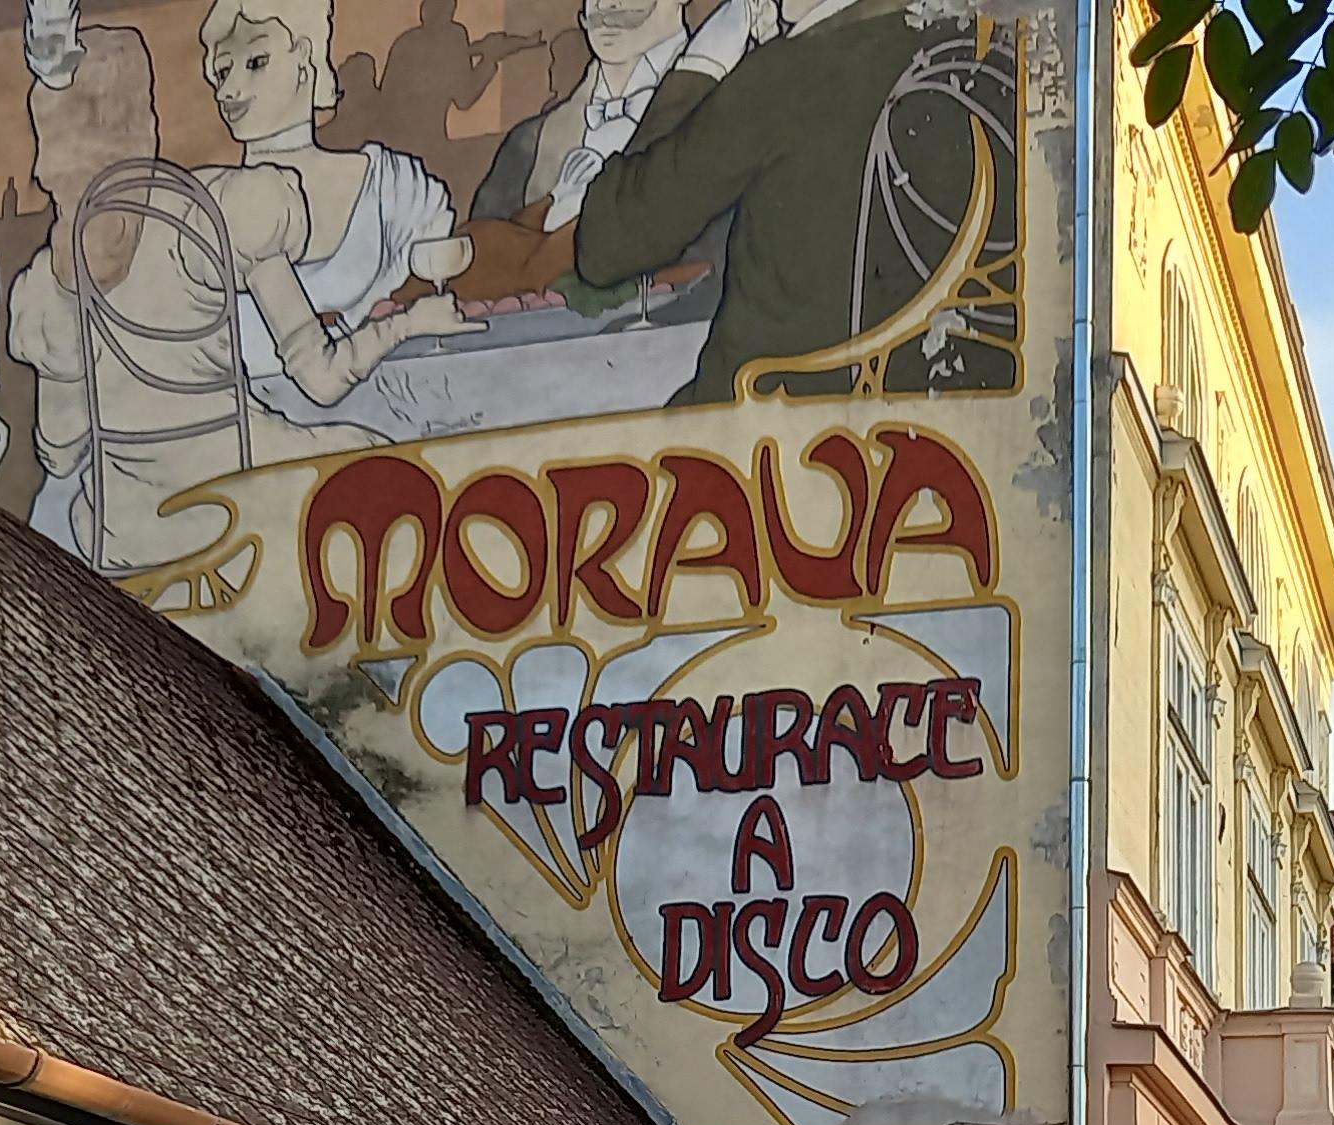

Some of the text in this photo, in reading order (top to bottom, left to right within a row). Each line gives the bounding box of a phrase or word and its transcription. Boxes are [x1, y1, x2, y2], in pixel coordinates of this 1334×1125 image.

[464, 678, 983, 850] RESTAURACE
[731, 795, 795, 893] A
[658, 891, 919, 1049] DISCO
